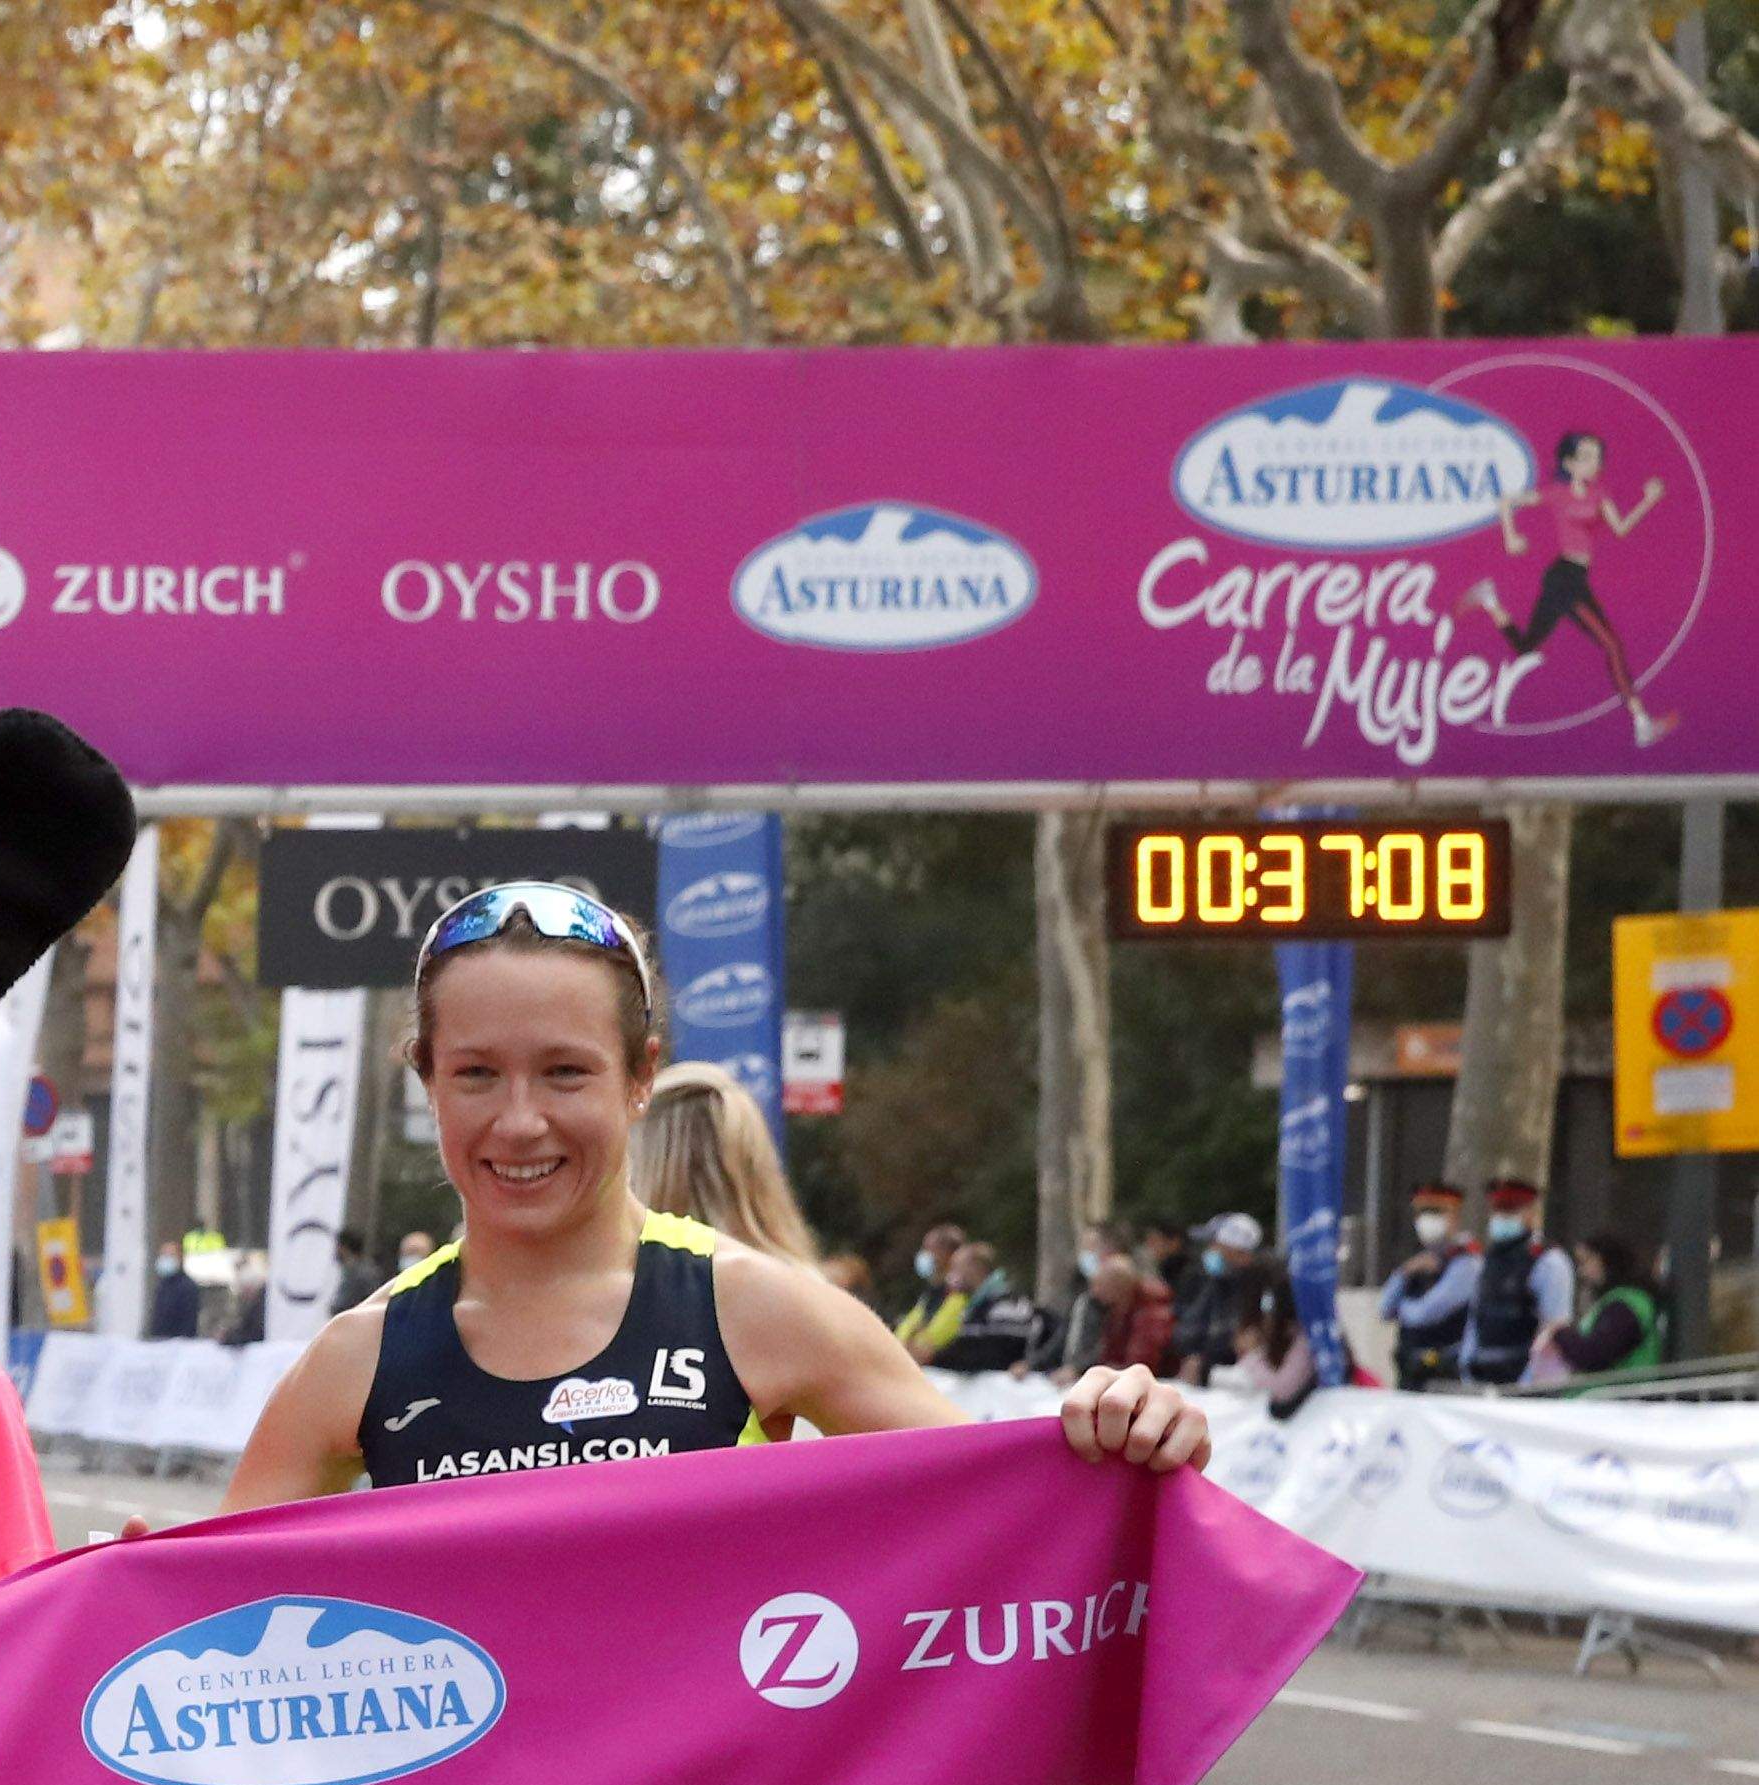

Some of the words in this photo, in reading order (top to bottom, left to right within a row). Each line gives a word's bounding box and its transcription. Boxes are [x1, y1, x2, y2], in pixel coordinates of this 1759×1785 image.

[1203, 447, 1503, 504] ASTURIANA
[52, 564, 284, 617] ZURICH
[381, 560, 661, 623] OYSHO
[758, 564, 1010, 613] ASTURIANA
[1138, 537, 1437, 630] Carrera
[1206, 629, 1265, 695] de
[1274, 626, 1317, 695] la
[1303, 617, 1545, 766] Mujer
[1137, 831, 1487, 923] 00:37:08
[313, 875, 601, 941] OYS
[551, 1382, 630, 1411] Acerko
[647, 1347, 707, 1400] LS
[417, 1437, 670, 1483] LASANSI.COM
[178, 1666, 308, 1692] CENTRAL
[321, 1652, 455, 1680] LECHERA
[118, 1680, 475, 1758] ASTURIANA
